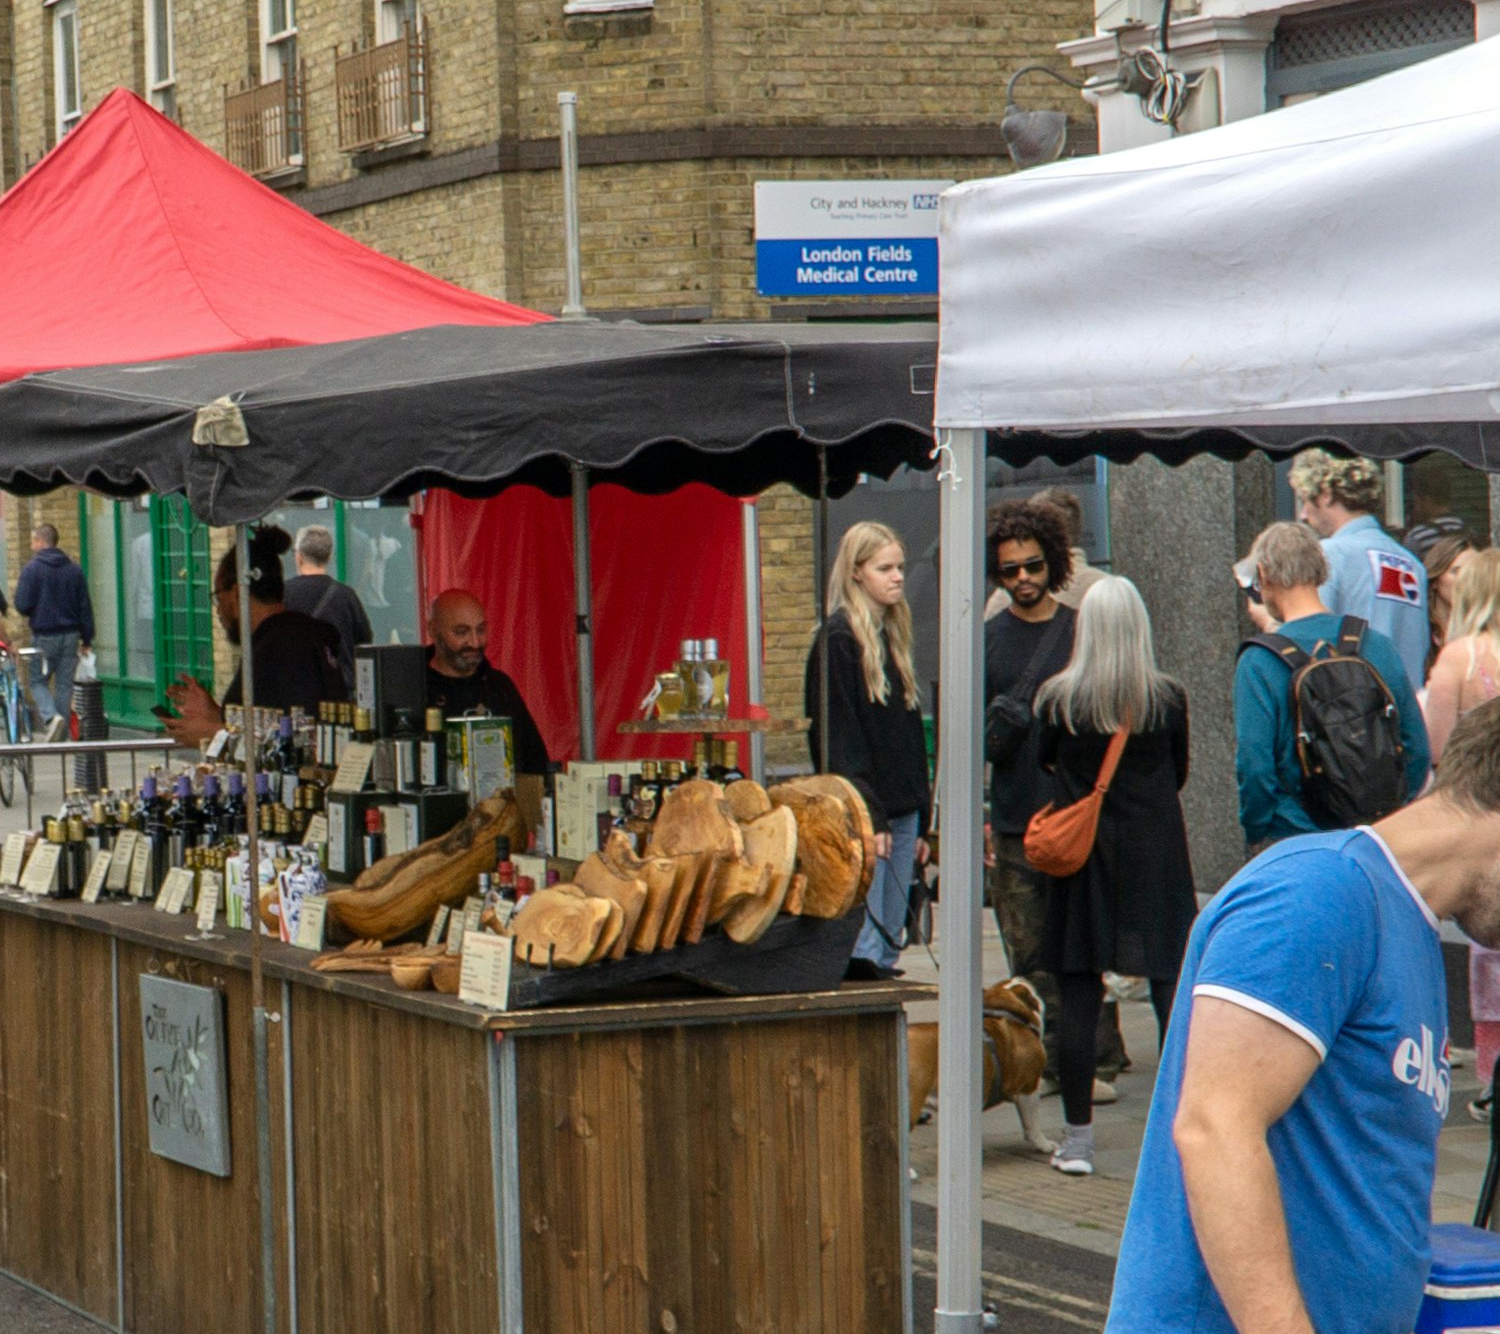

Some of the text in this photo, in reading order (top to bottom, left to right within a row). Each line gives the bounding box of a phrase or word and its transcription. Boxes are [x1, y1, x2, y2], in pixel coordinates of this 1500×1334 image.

[810, 198, 832, 211] City
[838, 197, 858, 208] and
[862, 197, 908, 211] Hackney
[801, 245, 912, 263] London Fields
[796, 266, 918, 283] Medical Centre
